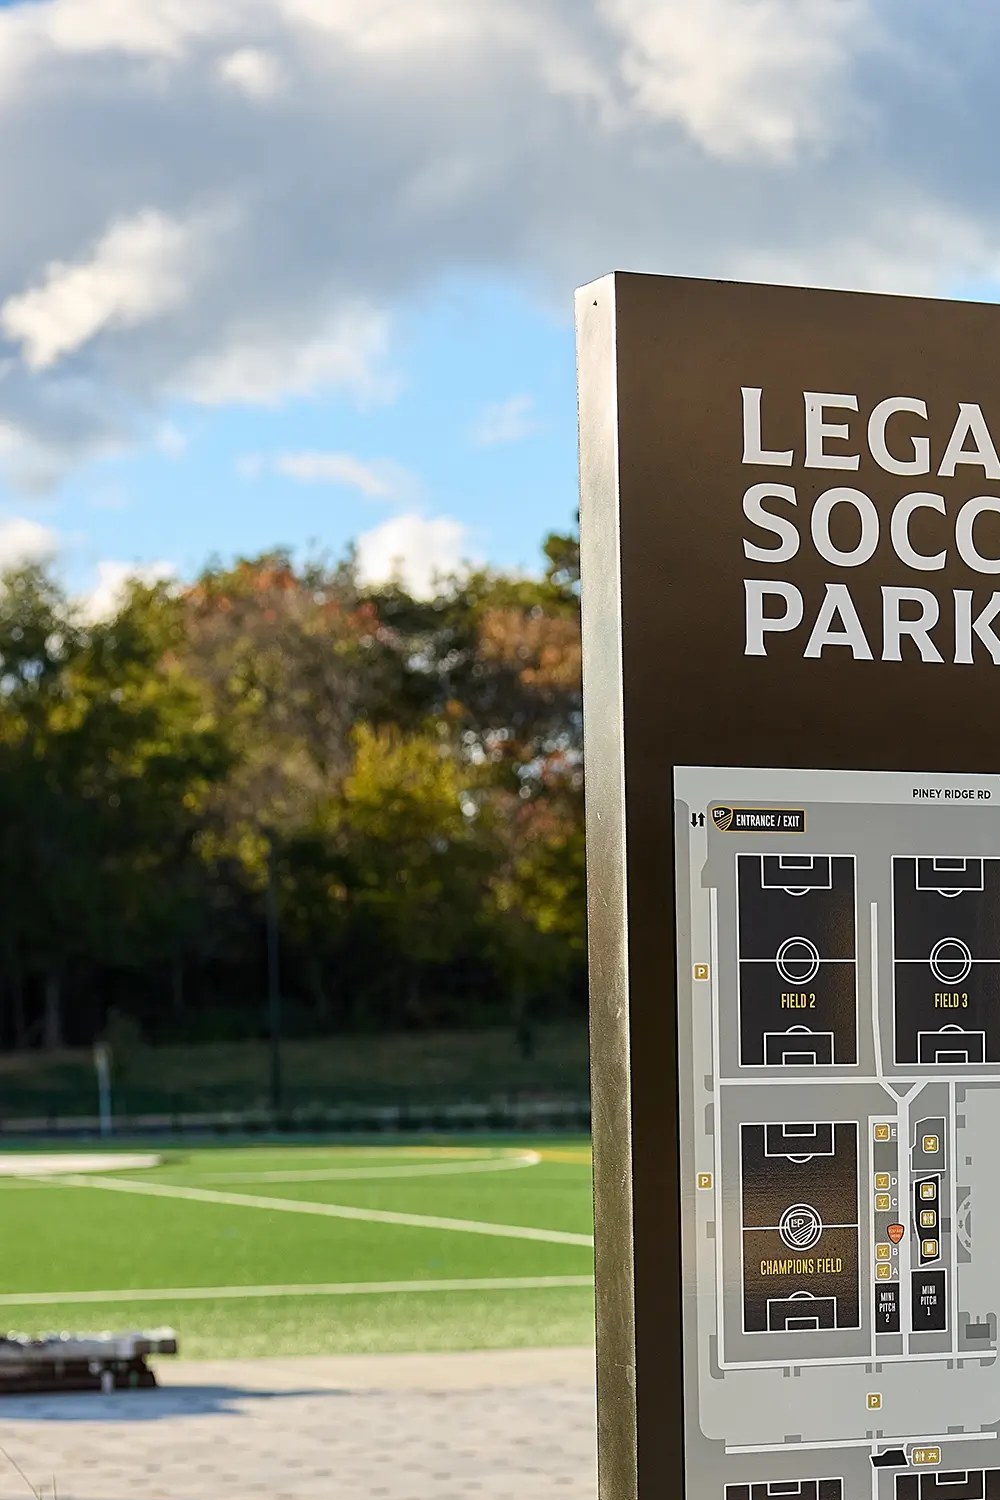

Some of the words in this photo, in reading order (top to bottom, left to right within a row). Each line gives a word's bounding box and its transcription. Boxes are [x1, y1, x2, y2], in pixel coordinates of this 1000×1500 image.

[912, 788, 942, 799] PINEY
[944, 789, 976, 800] RIDGE
[977, 790, 991, 800] RD
[736, 814, 775, 827] ENTRANCE
[783, 815, 800, 828] EXIT
[697, 967, 706, 977] P
[781, 993, 806, 1009] FIELD
[808, 993, 816, 1009] 2
[934, 993, 959, 1008] FIELD
[960, 993, 968, 1008] 3
[891, 1128, 897, 1137] E
[701, 1176, 709, 1186] P
[891, 1177, 897, 1186] D
[891, 1198, 897, 1207] C
[892, 1247, 899, 1256] B
[760, 1259, 814, 1276] CHAMPIONS
[817, 1258, 842, 1273] FIELD
[892, 1267, 899, 1276] A
[920, 1285, 936, 1294] MINI
[880, 1292, 895, 1302] MINI
[920, 1295, 937, 1306] PITCH
[879, 1302, 896, 1313] PITCH
[926, 1306, 931, 1316] 1
[885, 1313, 890, 1323] 2
[870, 1396, 878, 1406] P
